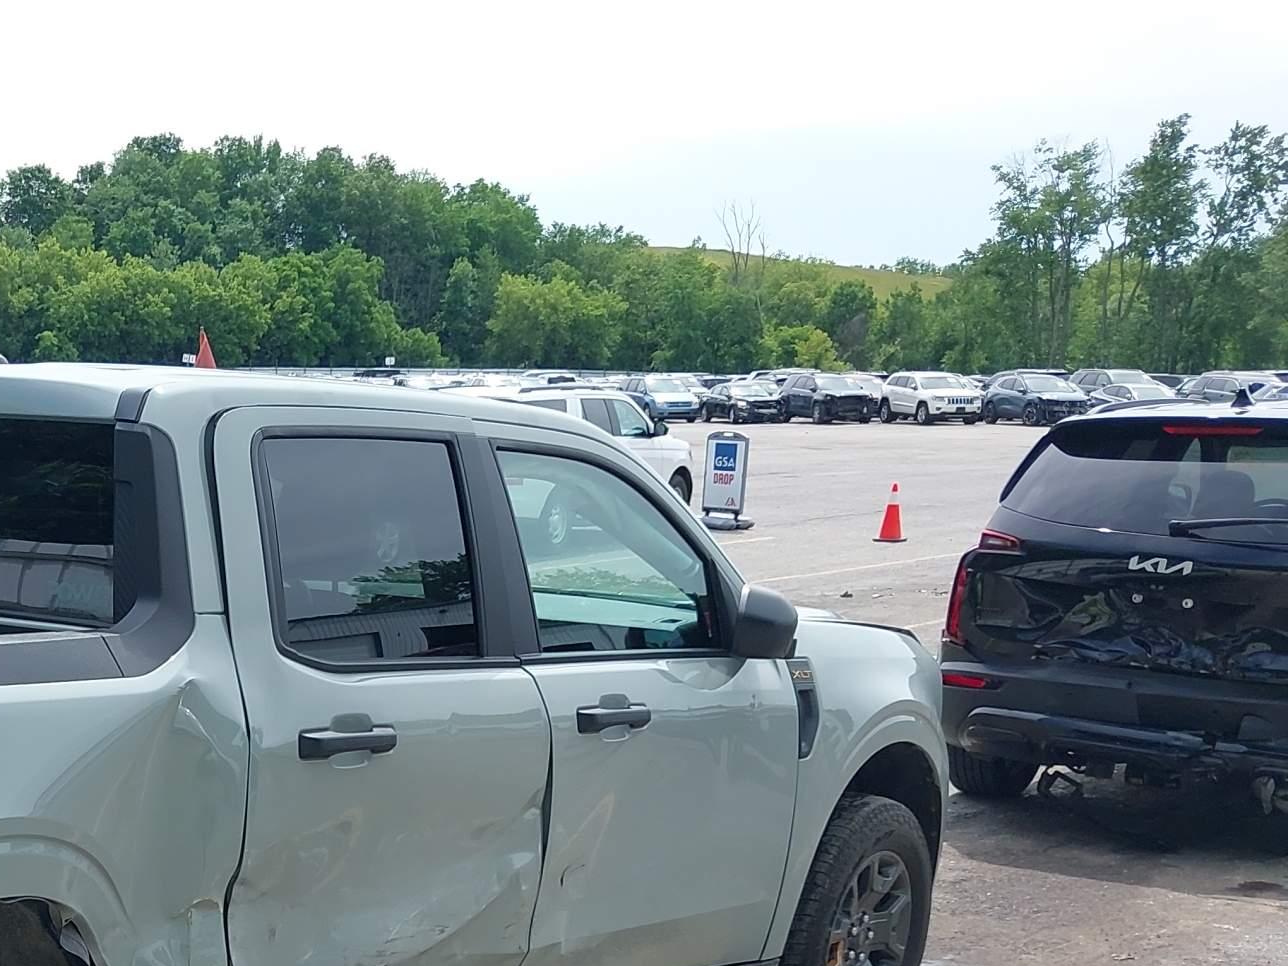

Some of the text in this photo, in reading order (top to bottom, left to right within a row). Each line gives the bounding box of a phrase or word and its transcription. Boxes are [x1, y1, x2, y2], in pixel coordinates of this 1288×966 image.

[715, 456, 734, 467] GSA
[713, 473, 734, 484] DROP
[1128, 555, 1193, 576] KIA
[792, 670, 812, 678] XLT
